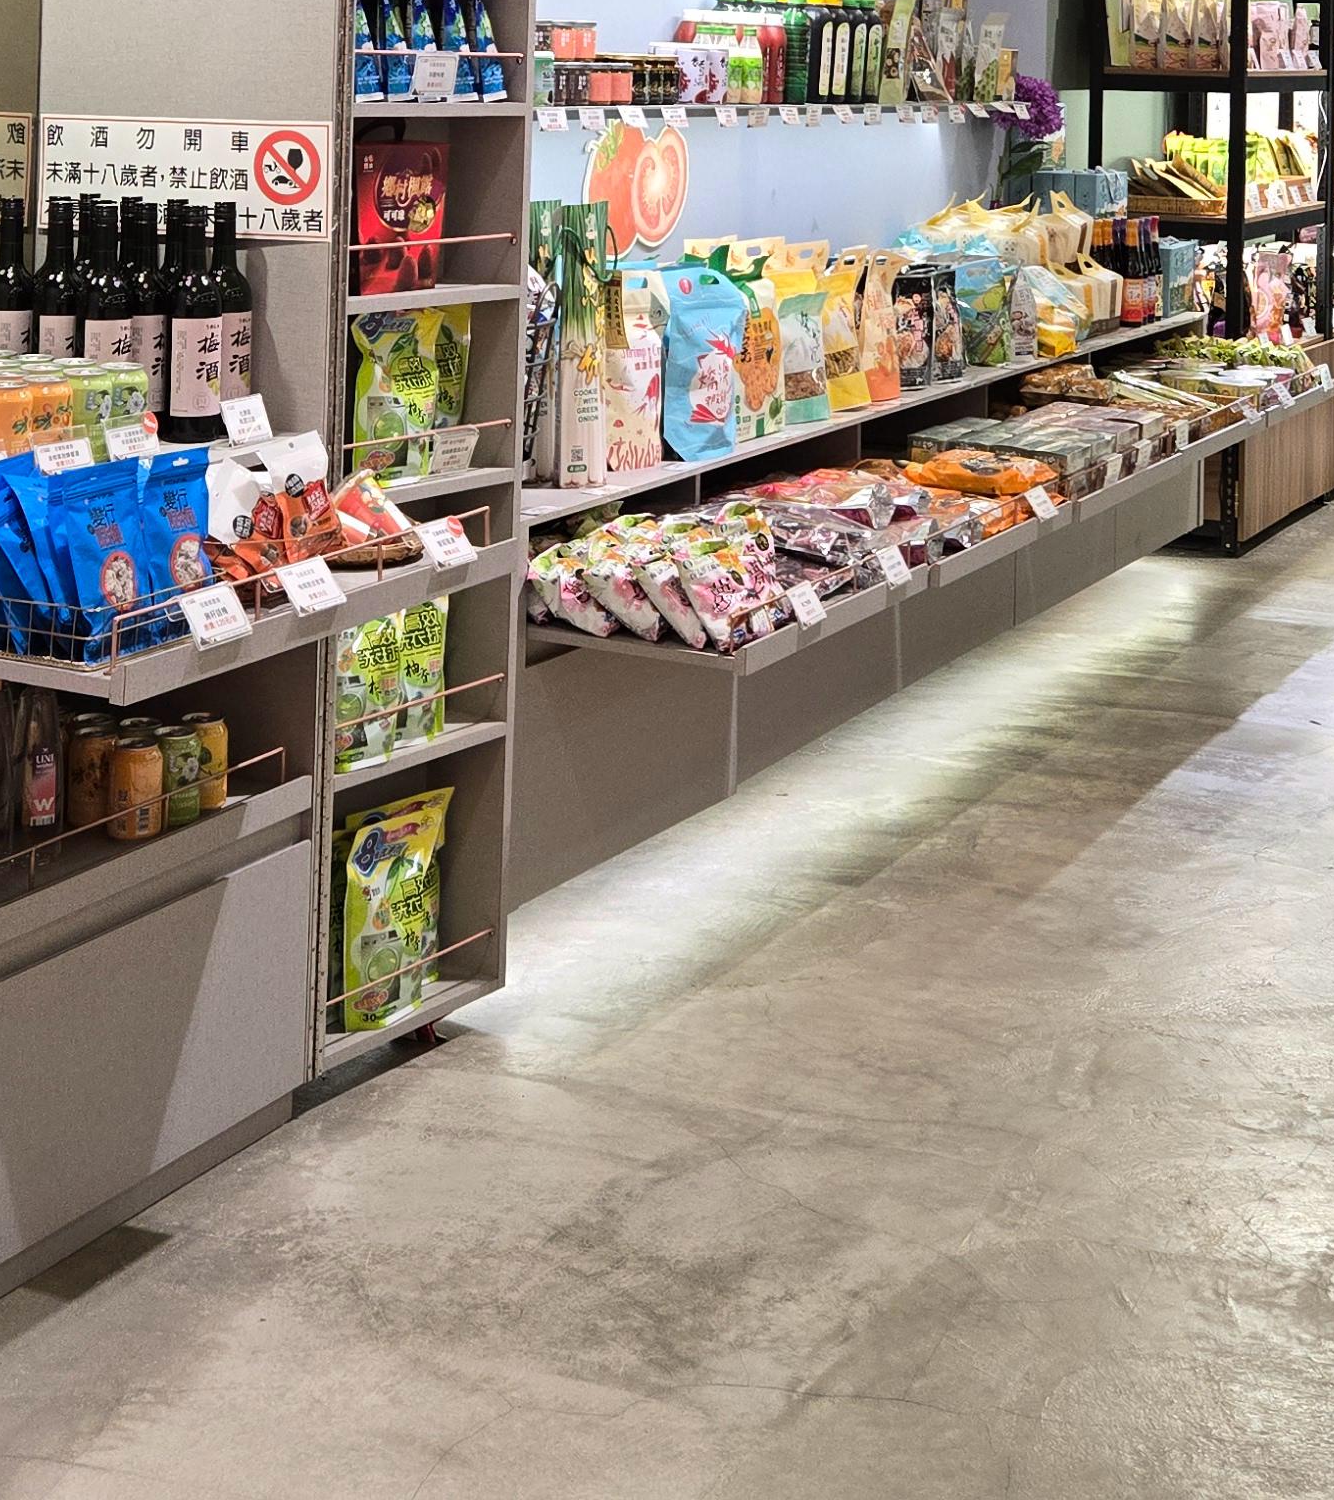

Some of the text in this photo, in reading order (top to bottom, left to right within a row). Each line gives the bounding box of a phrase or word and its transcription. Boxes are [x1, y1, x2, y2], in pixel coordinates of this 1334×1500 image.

[47, 126, 251, 153] 飲酒勿開車
[196, 332, 220, 382] 梅酒
[229, 326, 251, 375] 梅酒
[35, 753, 55, 765] UNI
[33, 797, 56, 813] W
